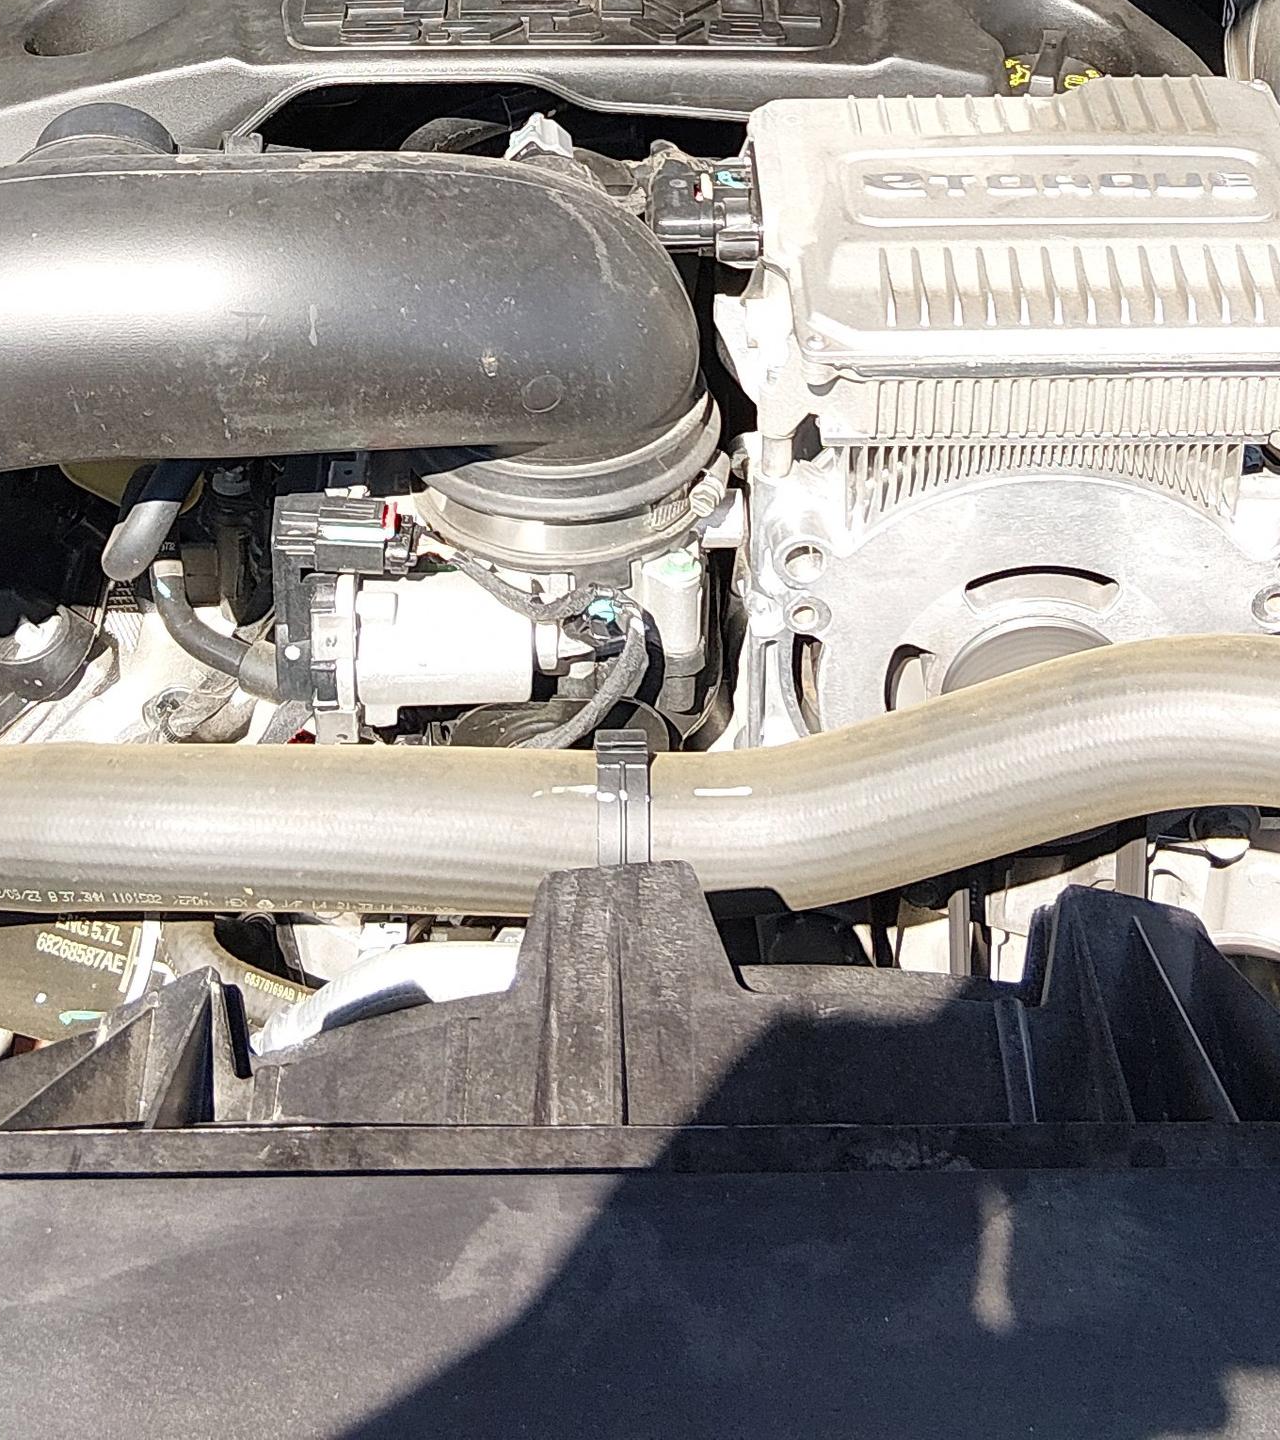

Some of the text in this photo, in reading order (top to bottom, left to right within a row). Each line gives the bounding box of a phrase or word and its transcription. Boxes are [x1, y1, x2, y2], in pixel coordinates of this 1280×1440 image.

[630, 17, 786, 46] V8
[90, 920, 124, 947] 5.7L
[36, 931, 128, 975] 68268587AE
